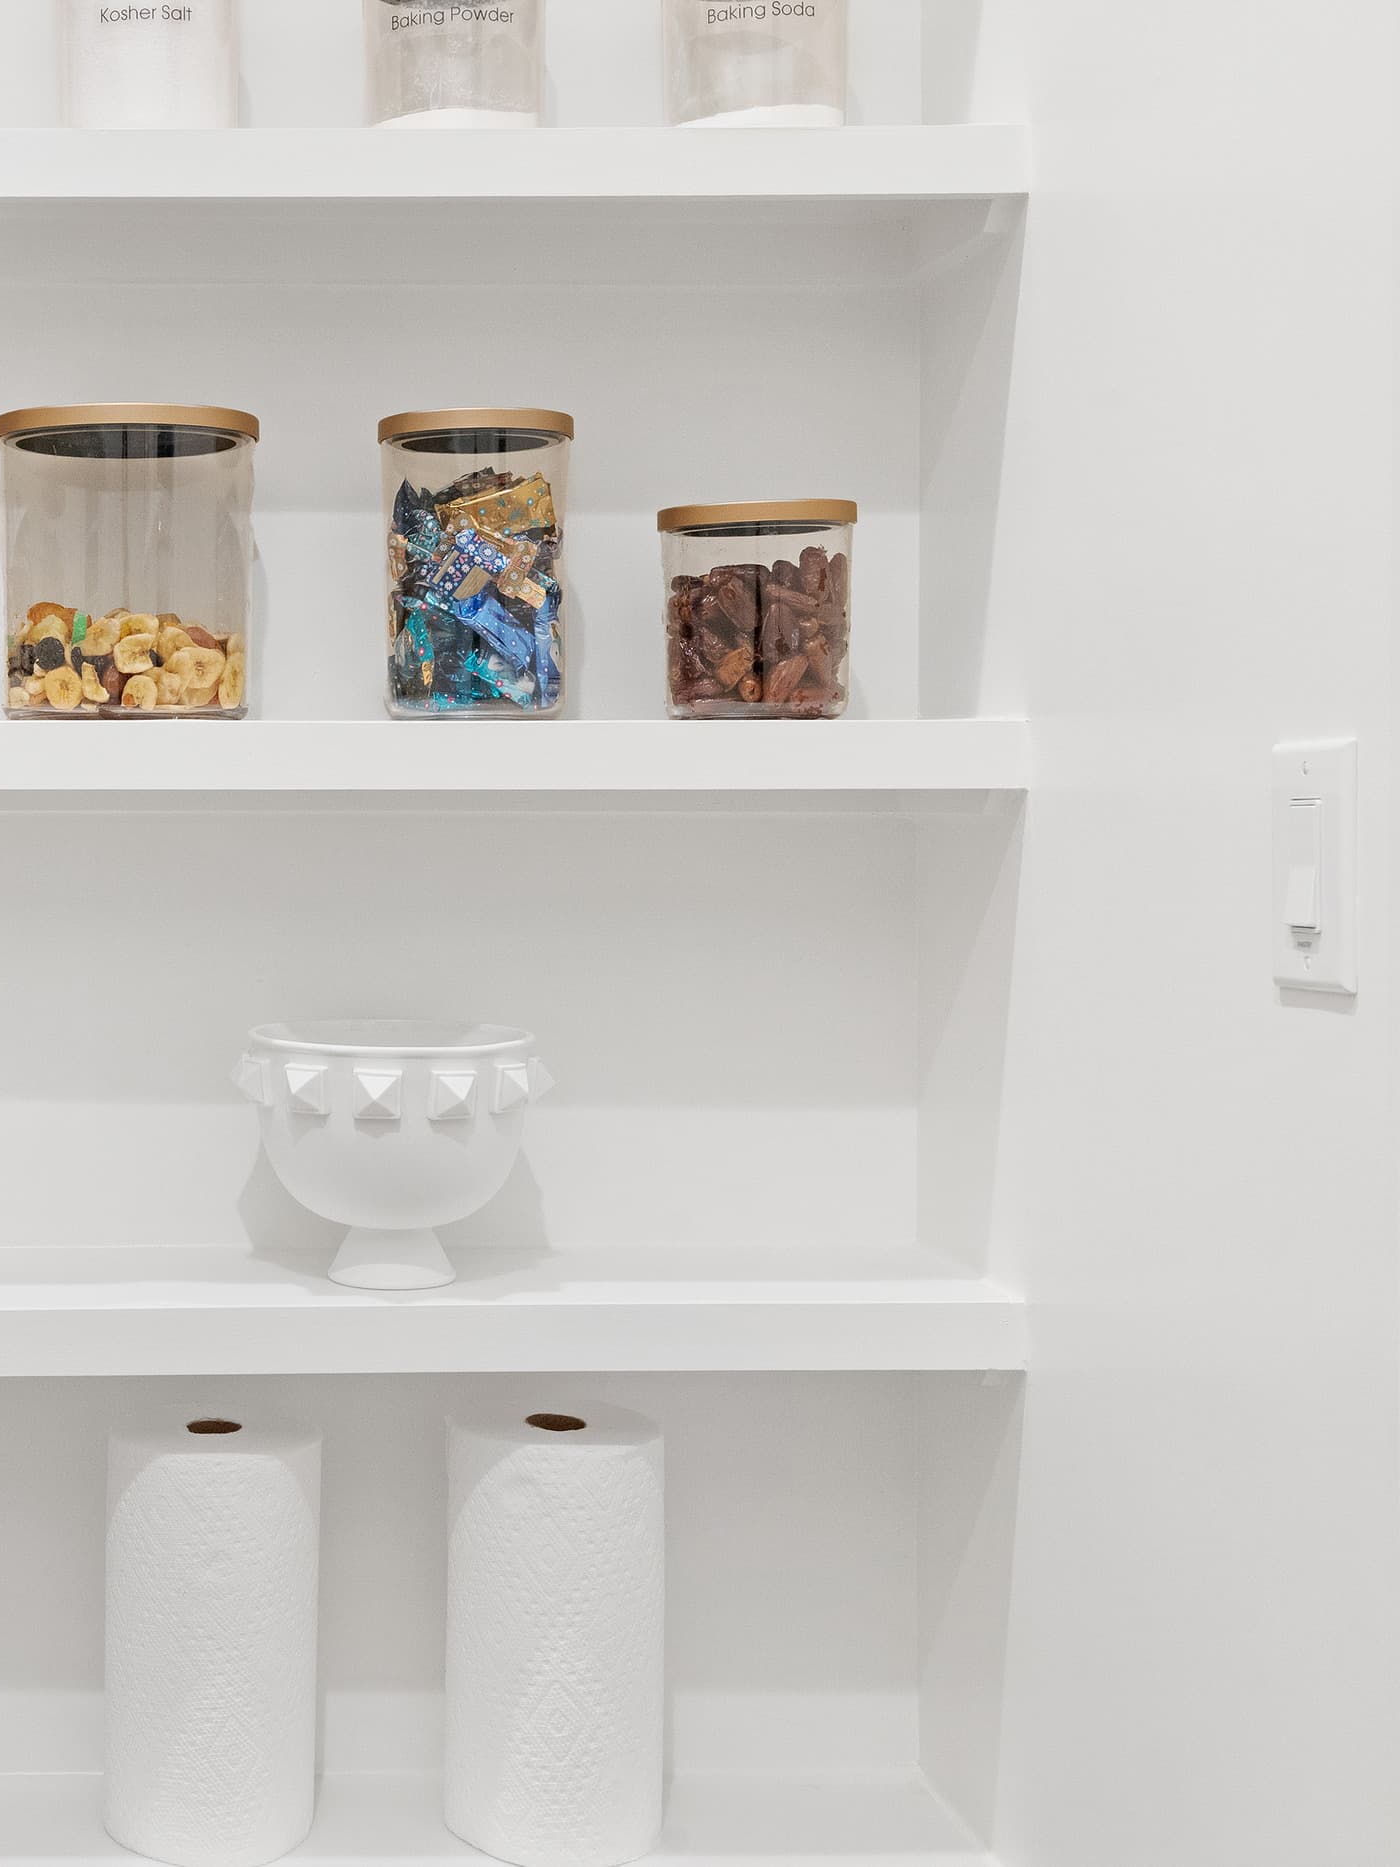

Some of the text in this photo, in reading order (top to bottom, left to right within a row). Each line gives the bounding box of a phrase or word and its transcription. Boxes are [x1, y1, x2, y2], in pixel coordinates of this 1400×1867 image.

[100, 4, 192, 23] Kosher Salt
[391, 6, 514, 30] Baking Powder
[707, 1, 815, 24] Baking Soda
